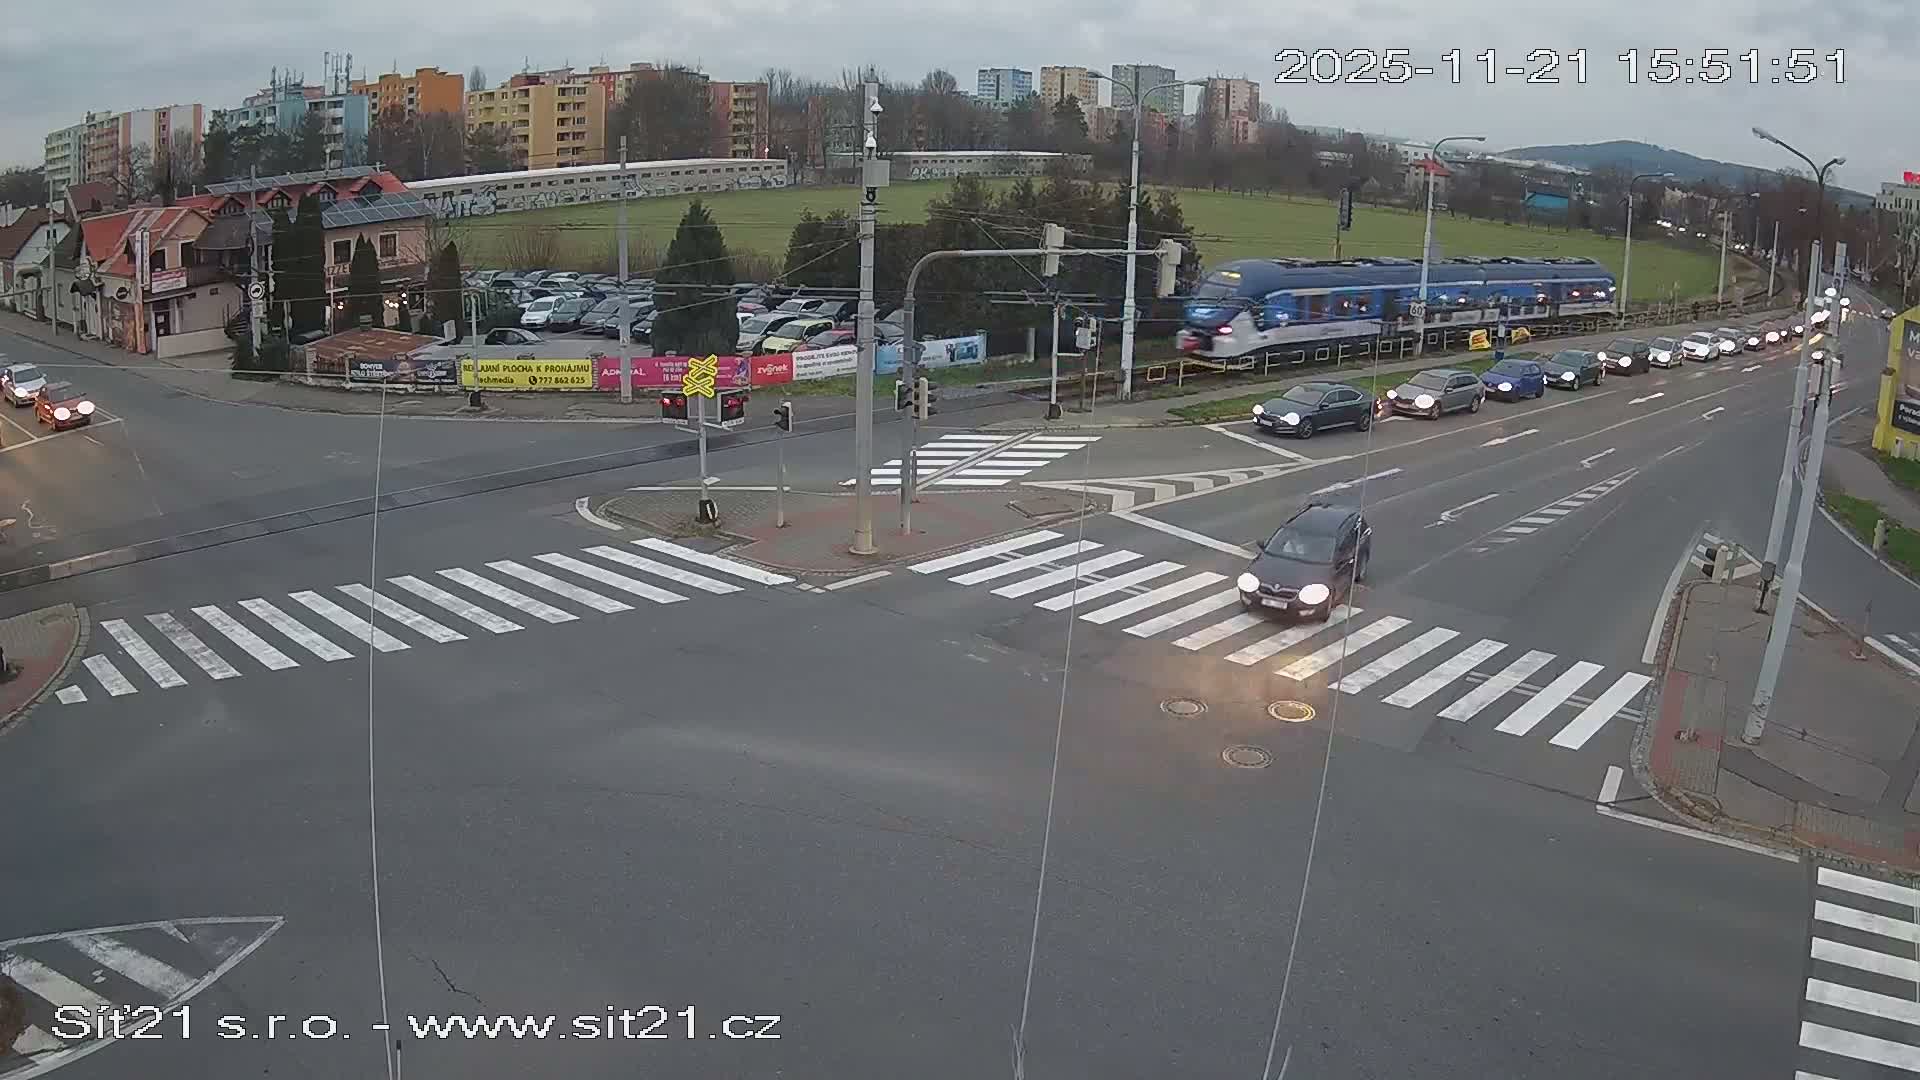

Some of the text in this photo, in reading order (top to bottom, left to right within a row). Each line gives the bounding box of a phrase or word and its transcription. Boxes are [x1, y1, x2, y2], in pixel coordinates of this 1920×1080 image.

[1411, 306, 1423, 315] 60
[463, 364, 590, 373] RELAMNÍ PLOCHA K PRONÁJMU
[477, 375, 585, 384] echmedia 777 862 625
